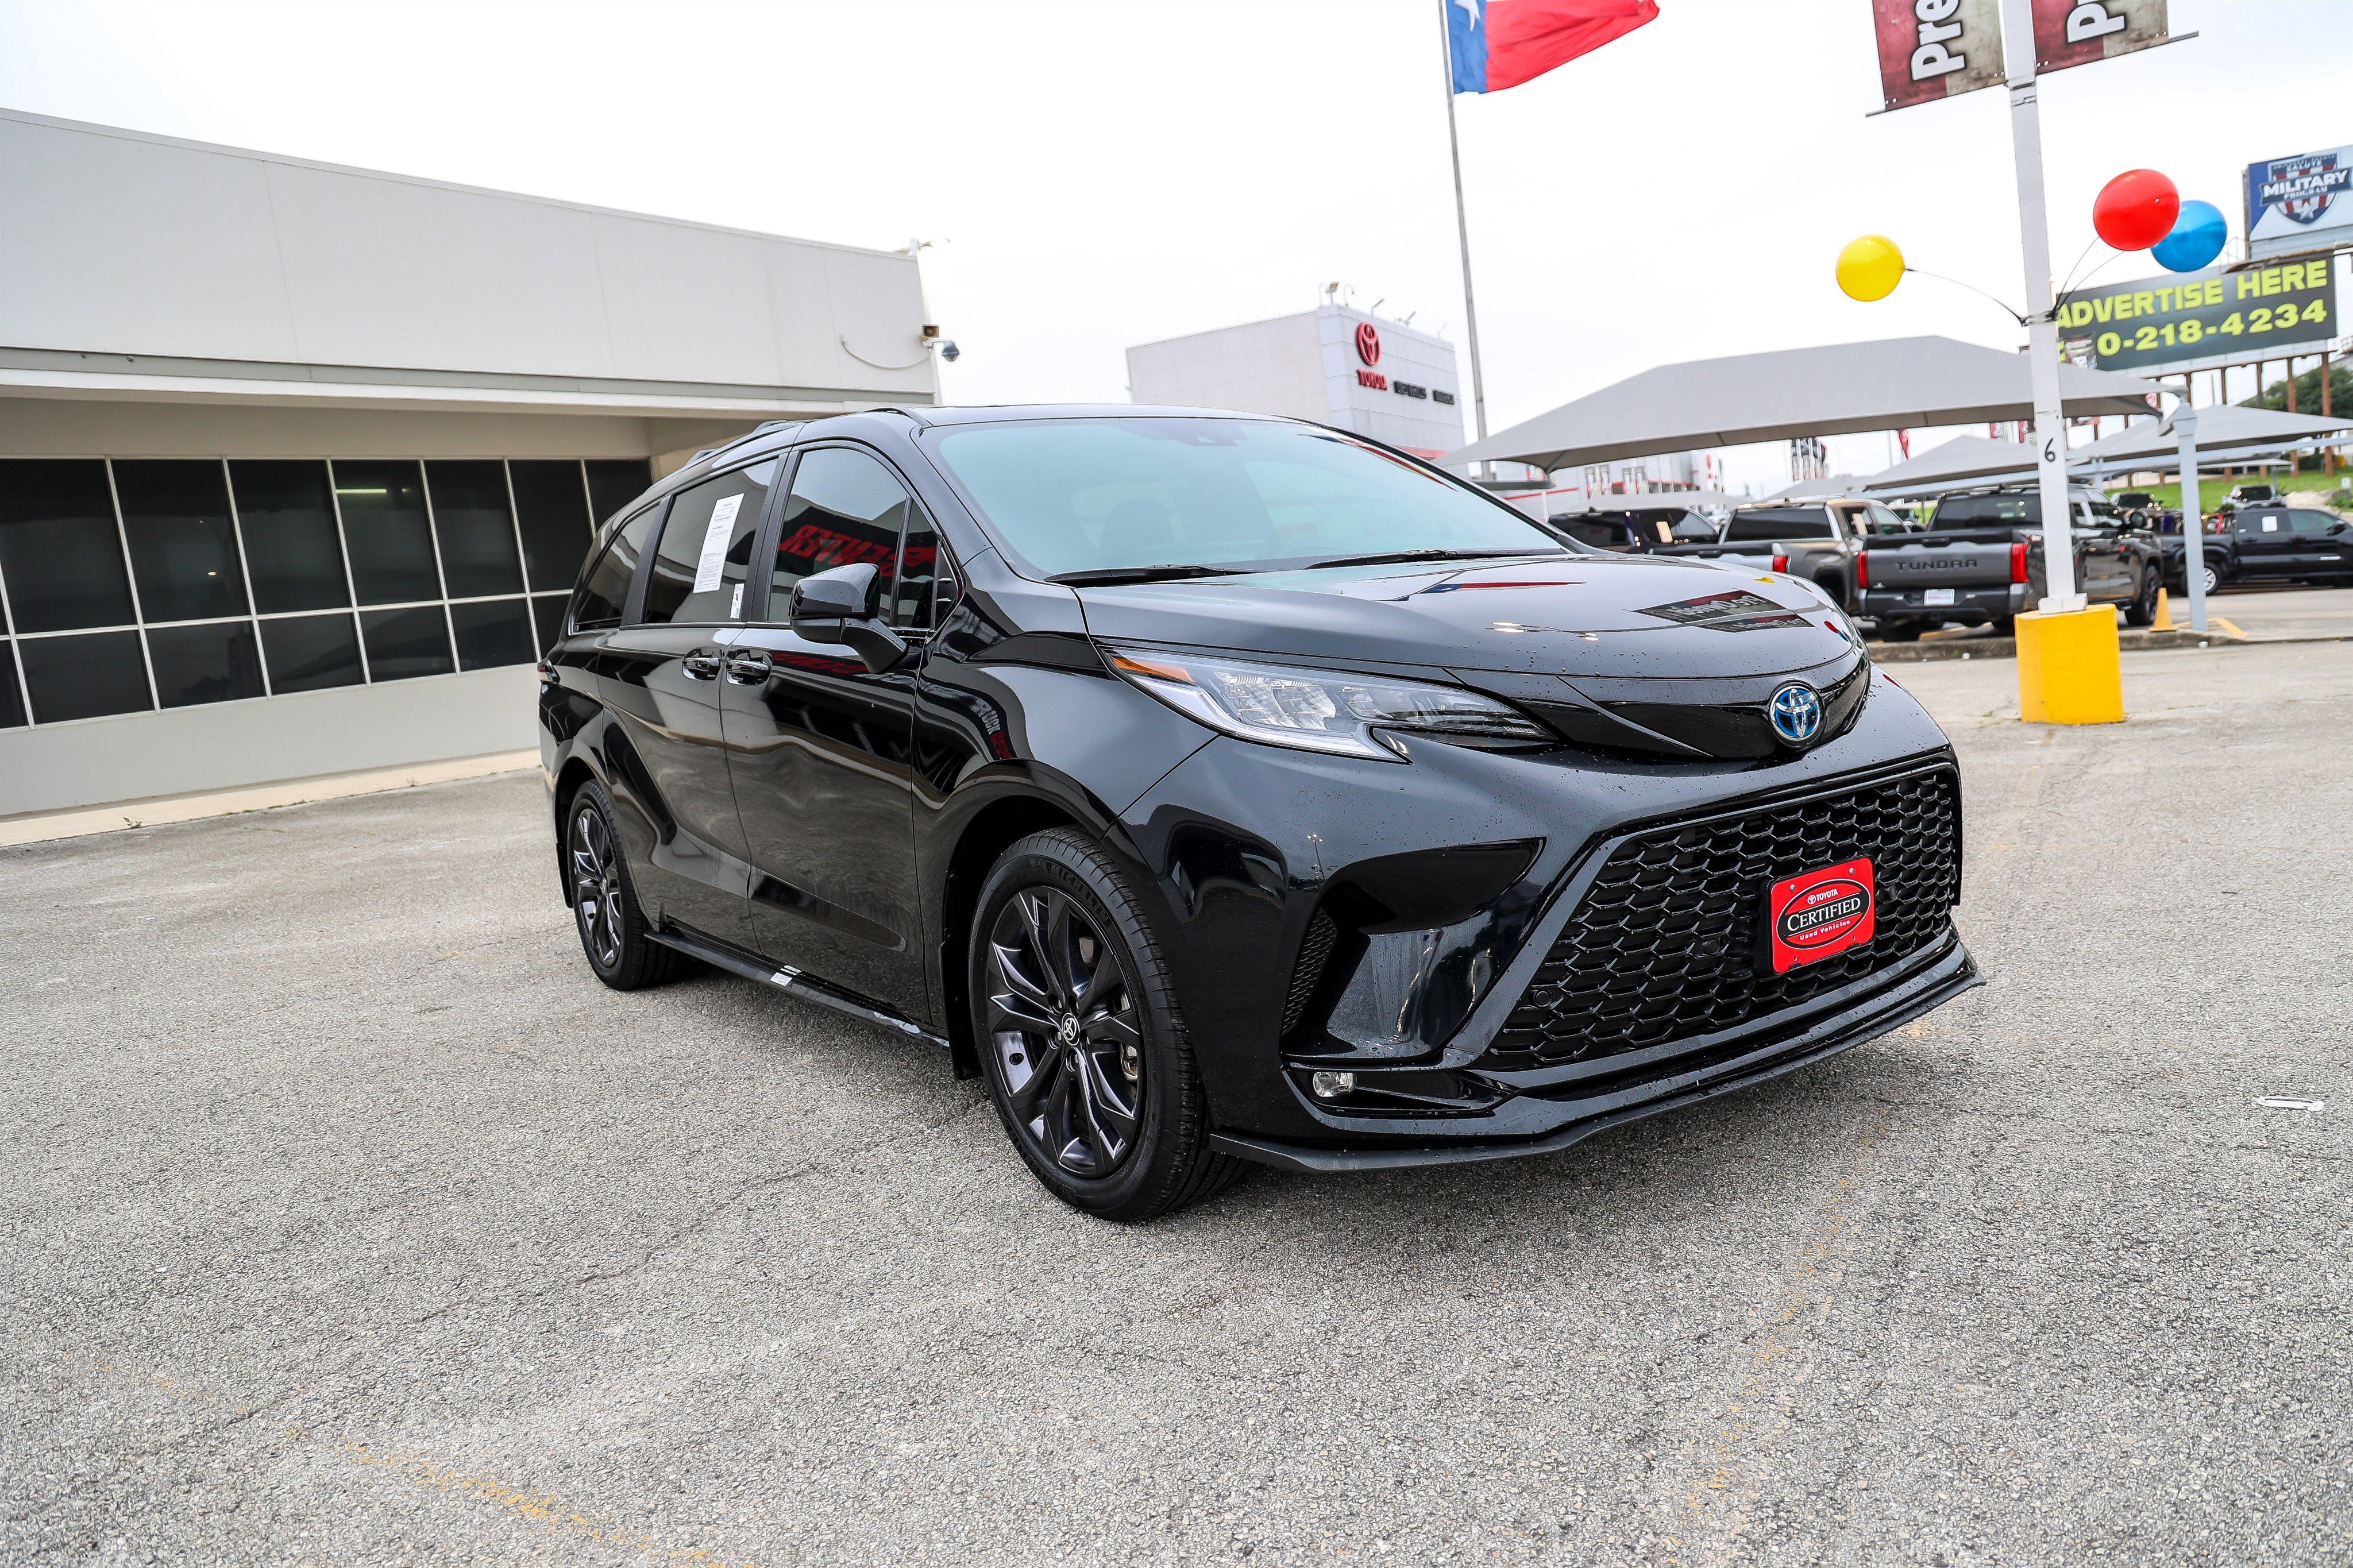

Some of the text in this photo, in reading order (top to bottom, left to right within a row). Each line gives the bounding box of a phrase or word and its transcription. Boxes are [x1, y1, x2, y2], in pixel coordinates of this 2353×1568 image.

[2066, 0, 2125, 43] P
[2263, 169, 2348, 198] MILITARY
[2057, 259, 2328, 329] ADVERTISE HERE
[2059, 299, 2328, 362] 0-218-4234
[2045, 437, 2055, 462] 6
[1896, 559, 1978, 572] TUNDRA
[1816, 889, 1838, 902] TOYOTA
[1787, 897, 1861, 932] CERTIFIED
[1799, 920, 1851, 941] Used Vehicles
